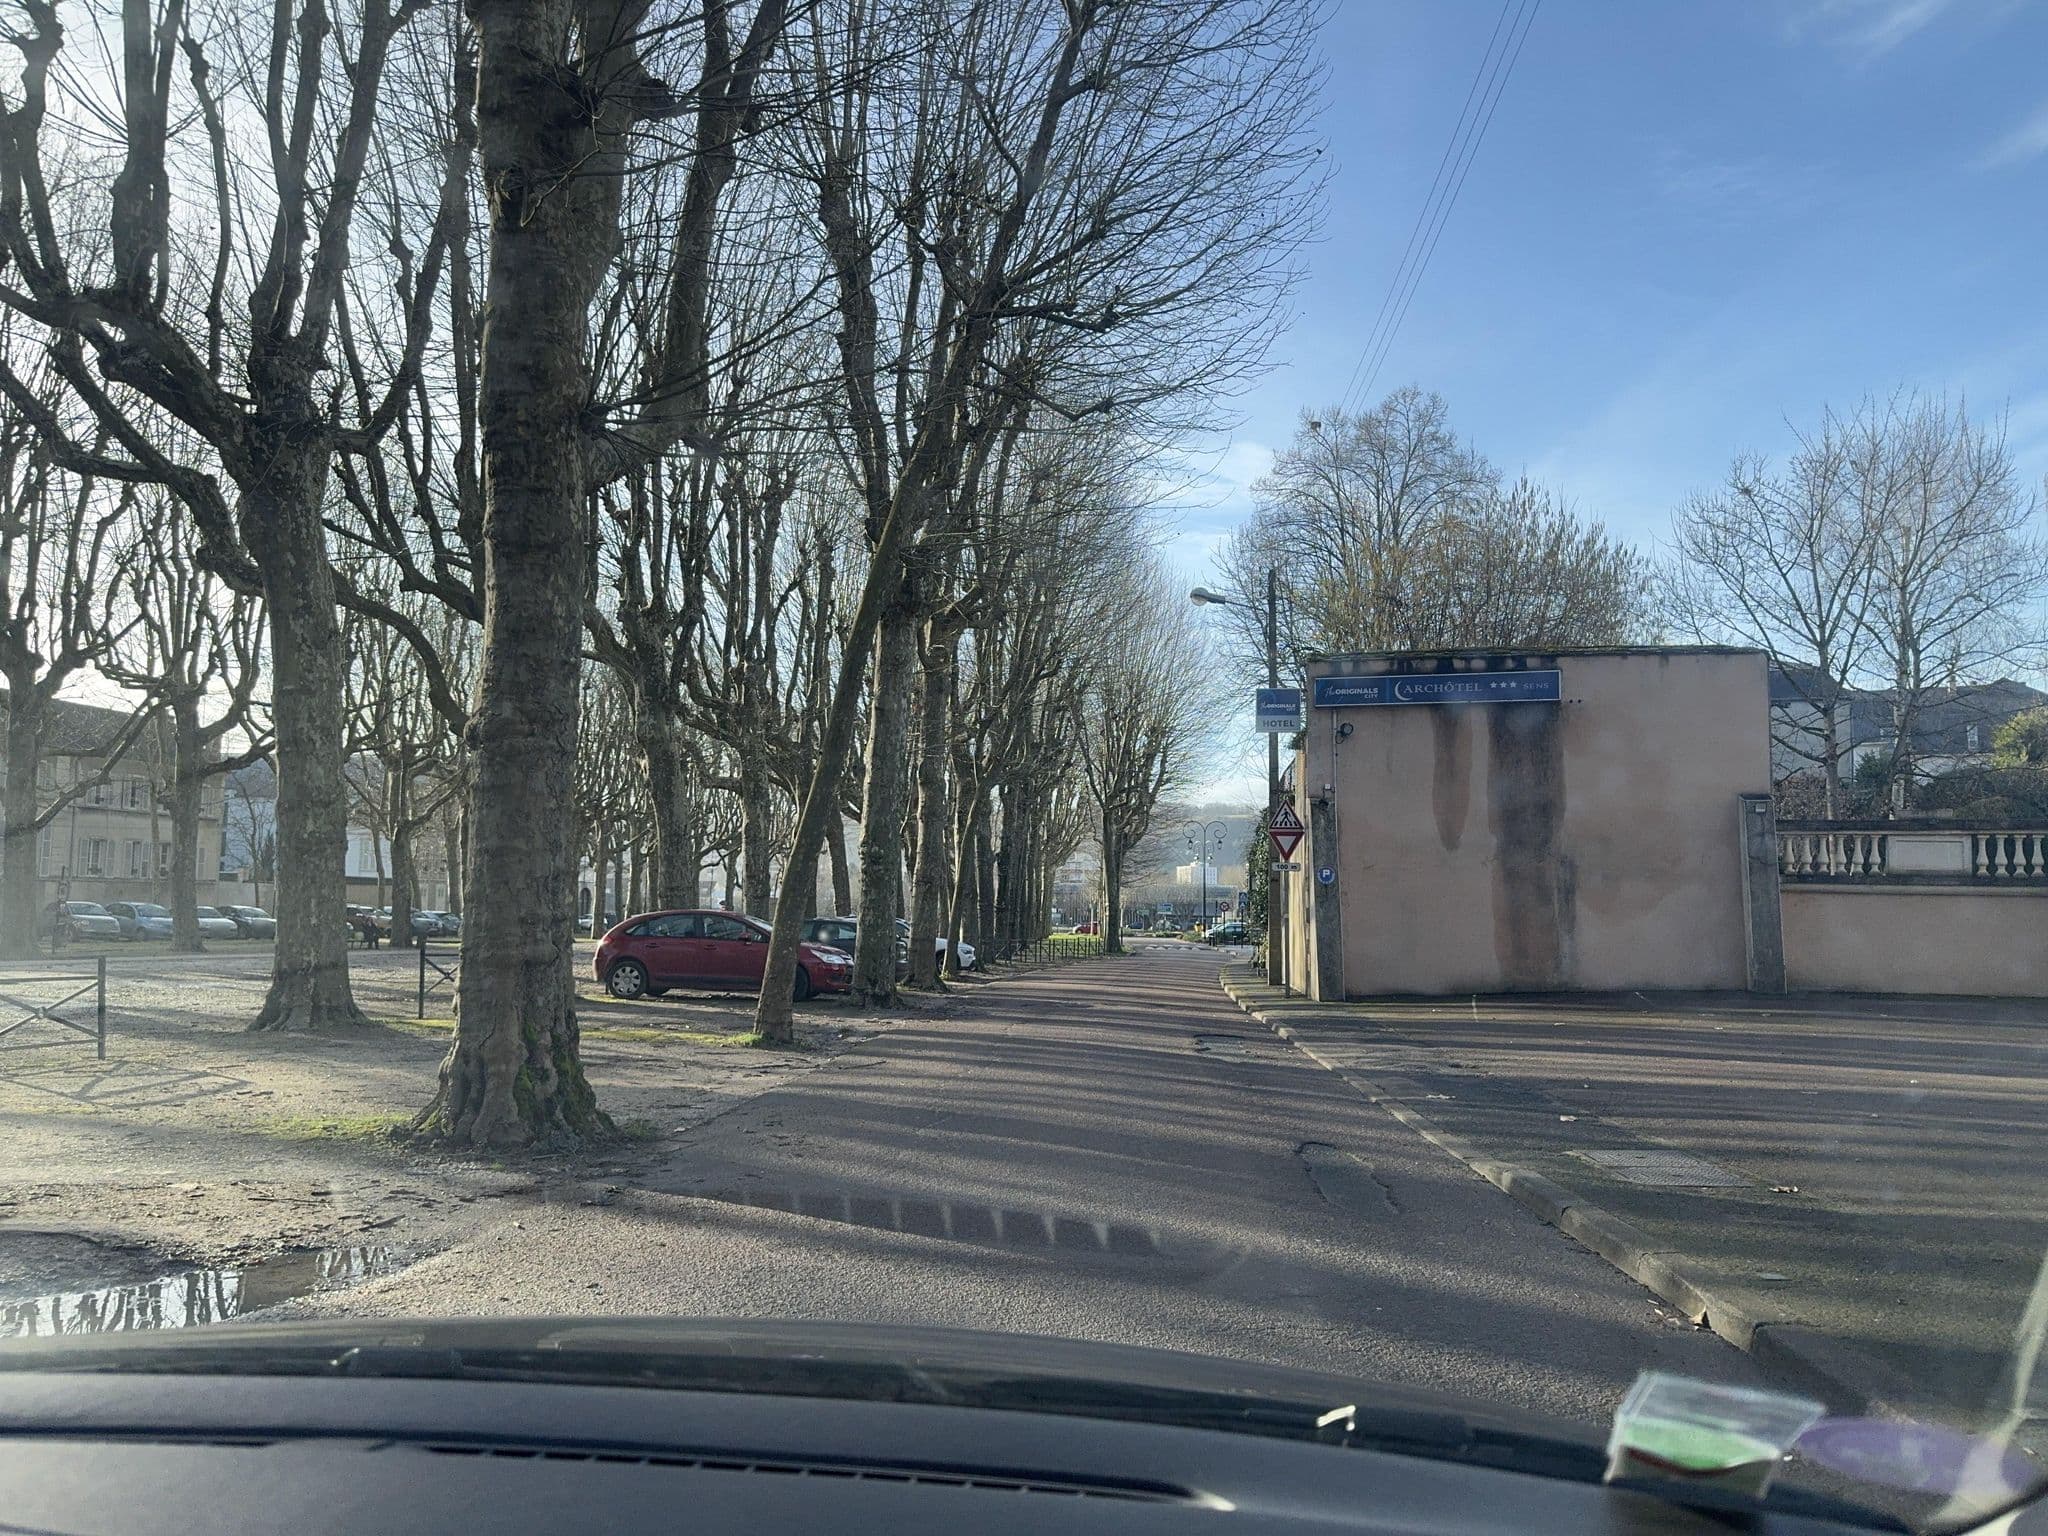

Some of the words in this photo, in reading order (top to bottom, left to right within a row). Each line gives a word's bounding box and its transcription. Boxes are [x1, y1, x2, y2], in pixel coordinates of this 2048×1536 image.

[1335, 687, 1379, 695] ORIGINALS
[1403, 681, 1483, 694] ARCHÔTEL
[1523, 682, 1550, 690] SENS
[1262, 719, 1296, 728] HOTEL
[1322, 869, 1331, 878] P
